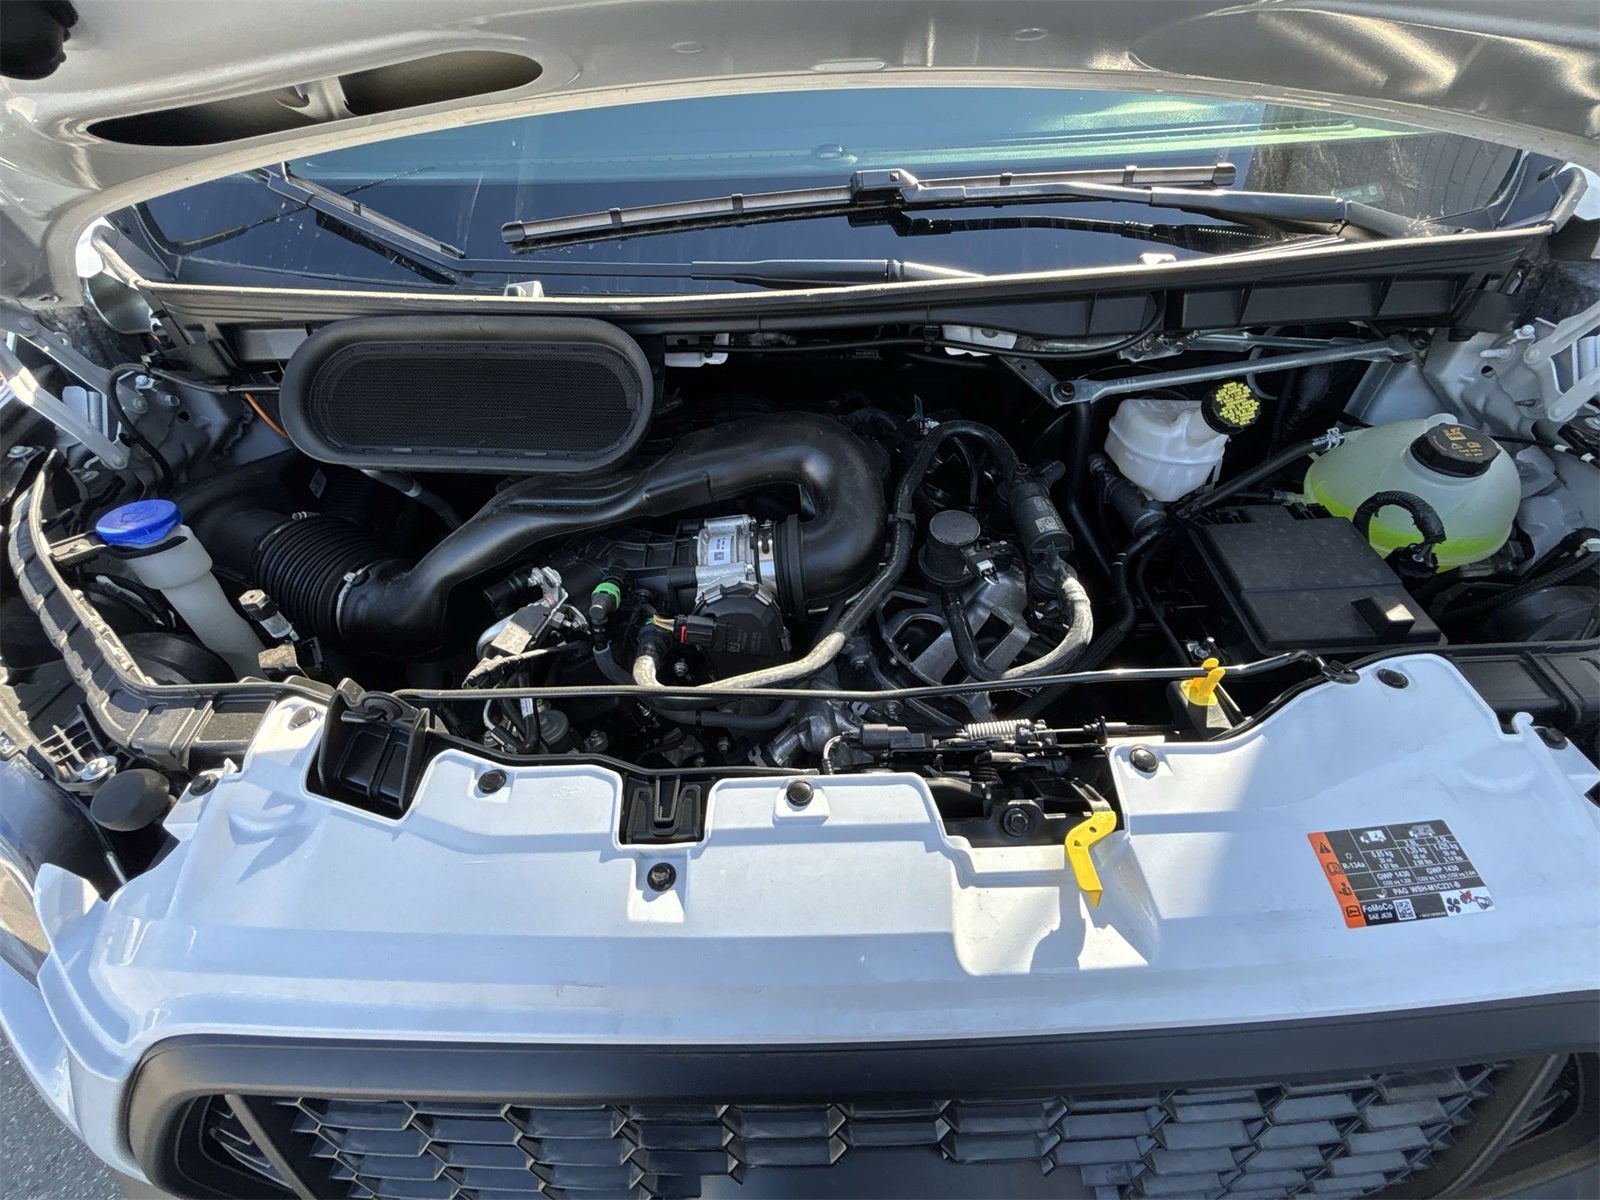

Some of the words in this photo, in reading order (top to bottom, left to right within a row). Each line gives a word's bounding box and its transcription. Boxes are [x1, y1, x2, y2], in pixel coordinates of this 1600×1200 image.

[1342, 862, 1366, 871] R-134a
[1426, 866, 1443, 875] GWP
[1443, 864, 1460, 872] 1430
[1376, 872, 1394, 880] GWP
[1395, 870, 1411, 878] 1430
[1393, 886, 1409, 896] PAG
[1362, 902, 1394, 913] FoMoCo
